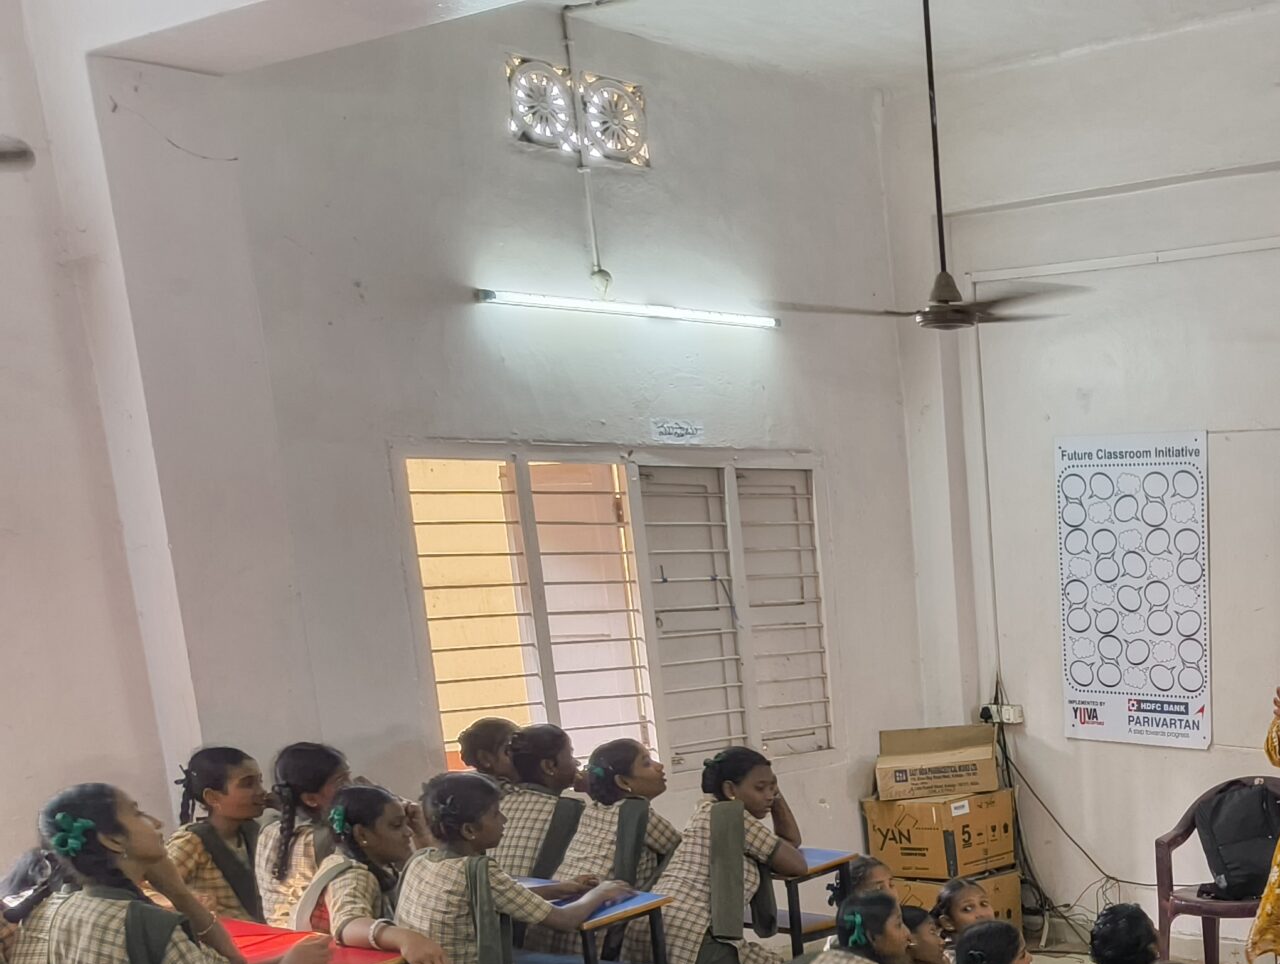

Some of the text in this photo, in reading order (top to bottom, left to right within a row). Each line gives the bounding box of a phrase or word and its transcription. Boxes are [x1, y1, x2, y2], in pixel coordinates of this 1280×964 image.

[1061, 446, 1200, 461] Future Classroom Initiative
[1141, 701, 1186, 713] HDFC BANK
[1072, 706, 1099, 725] YUVA
[1128, 715, 1200, 731] PARIVARTAN
[961, 823, 972, 844] 5
